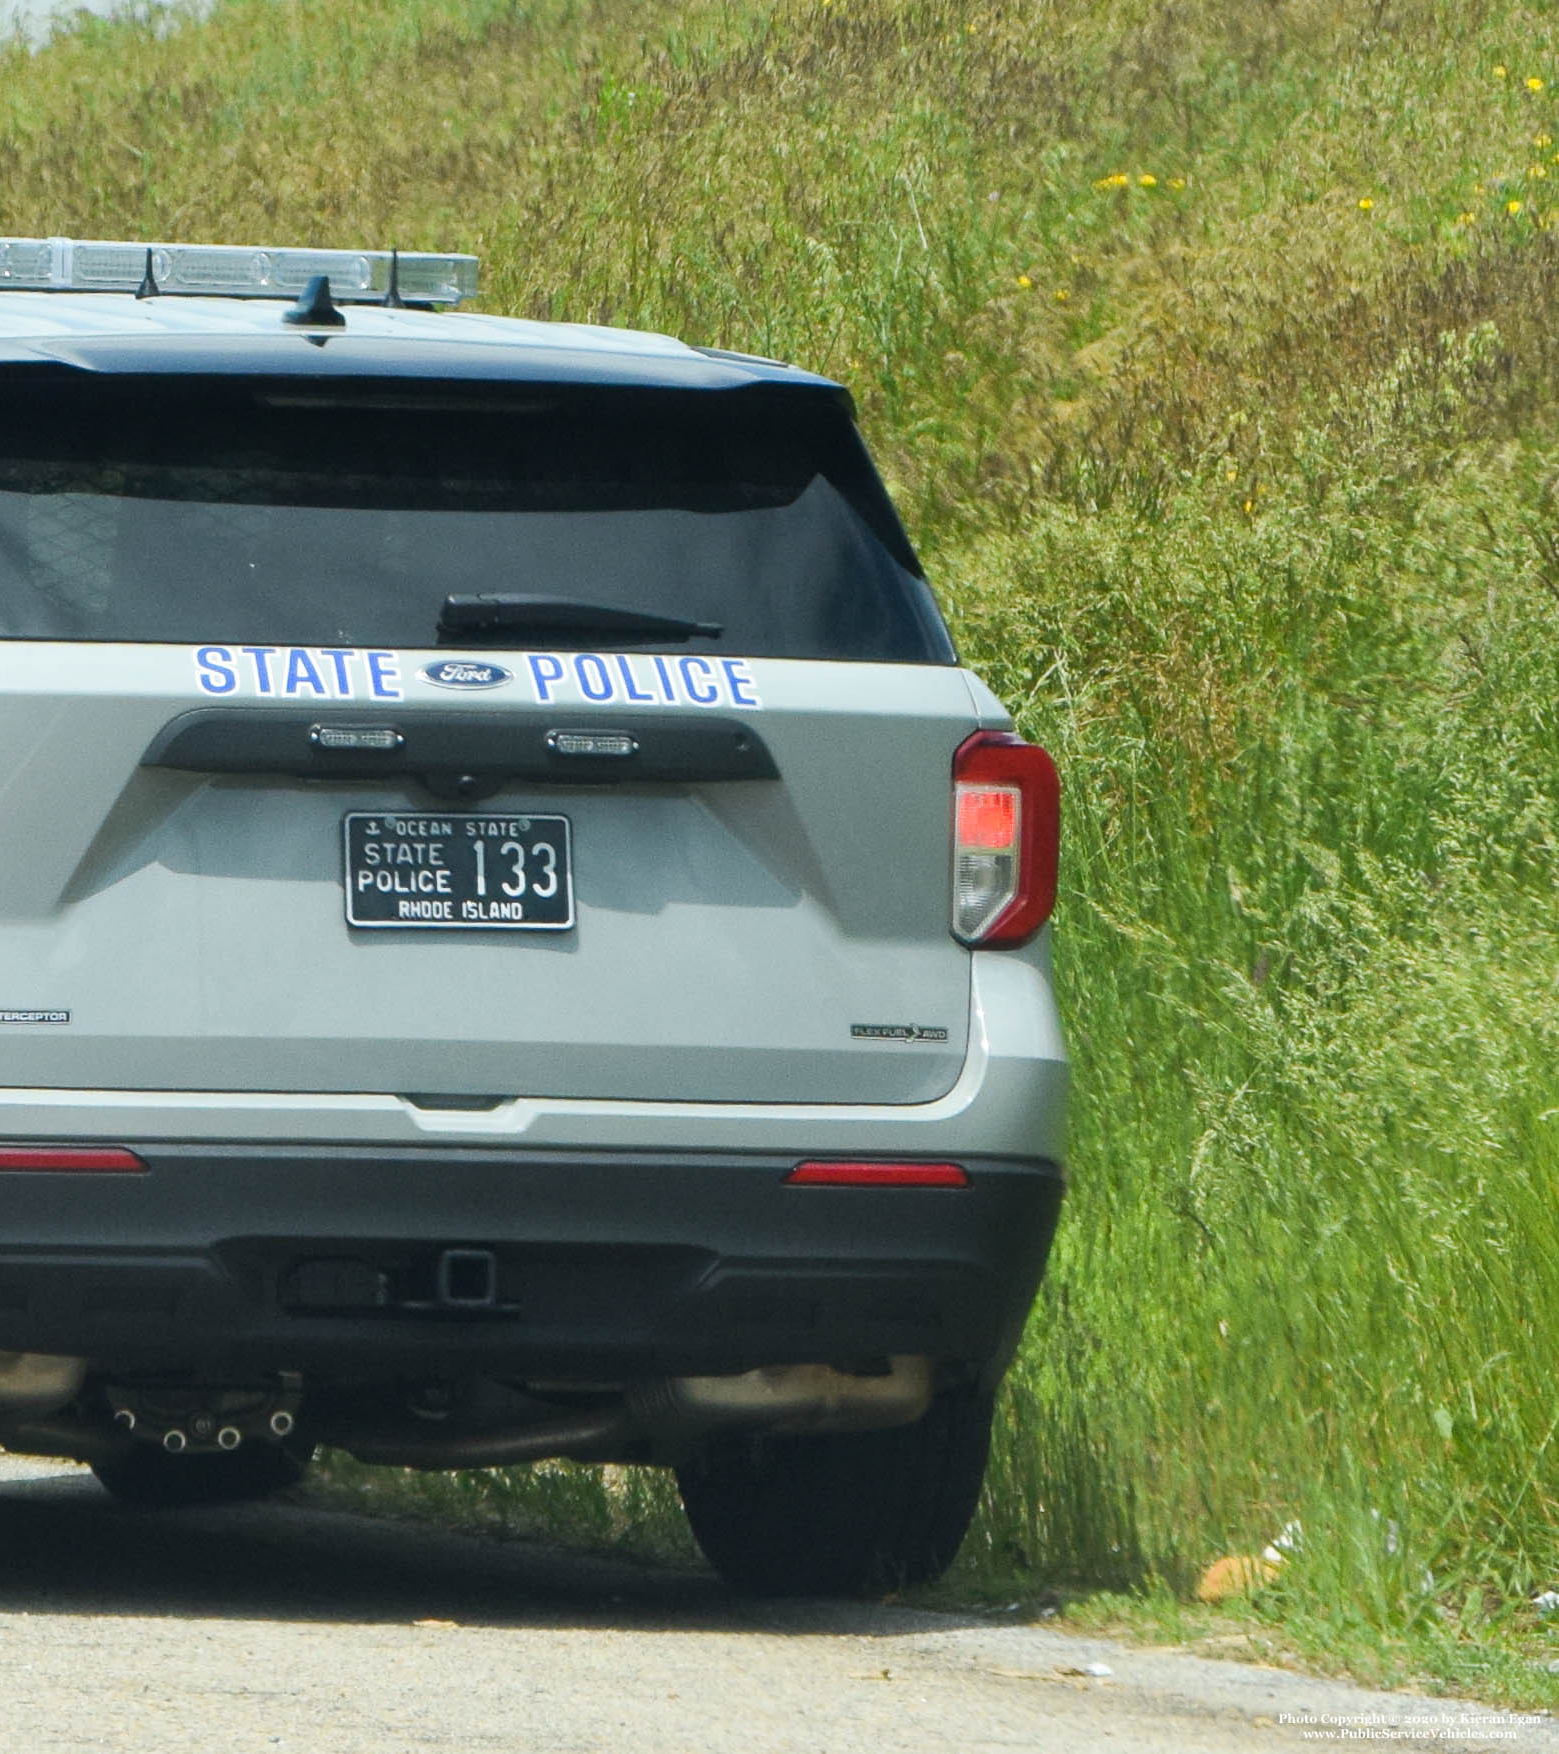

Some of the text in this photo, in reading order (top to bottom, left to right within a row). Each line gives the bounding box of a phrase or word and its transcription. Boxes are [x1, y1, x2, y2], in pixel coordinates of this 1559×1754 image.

[196, 646, 401, 697] STATE
[440, 663, 492, 682] Ford
[530, 654, 762, 706] POLICE
[396, 821, 519, 837] OCEAN STATE
[364, 843, 444, 866] STATE
[474, 840, 558, 897] 133
[358, 870, 452, 893] POLICE
[398, 900, 523, 920] RHODE ISLAND
[922, 1030, 946, 1039] AWD
